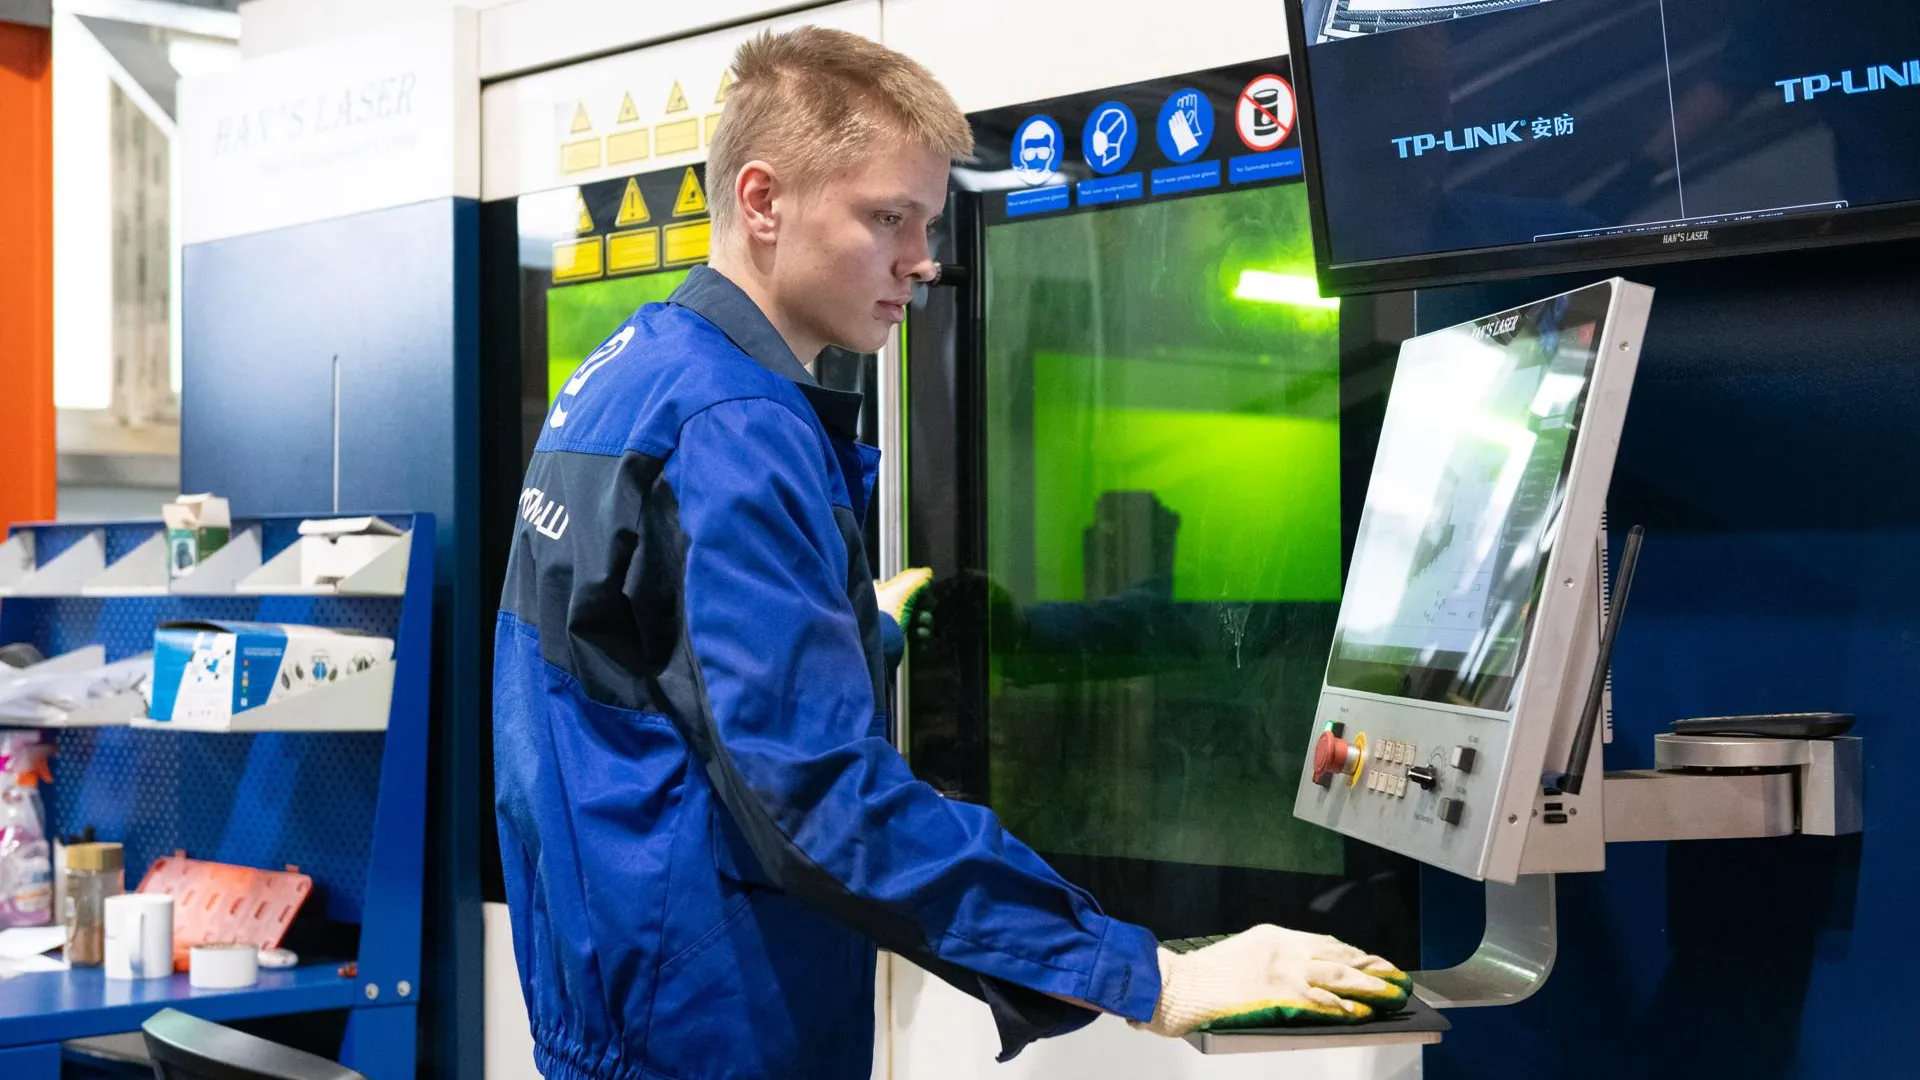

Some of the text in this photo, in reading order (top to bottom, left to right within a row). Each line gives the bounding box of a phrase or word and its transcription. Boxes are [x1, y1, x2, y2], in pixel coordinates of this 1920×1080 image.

[314, 71, 417, 135] LASER
[1531, 113, 1574, 139] 安防
[1663, 231, 1709, 244] HAN'S LASER
[1492, 315, 1519, 336] LASER
